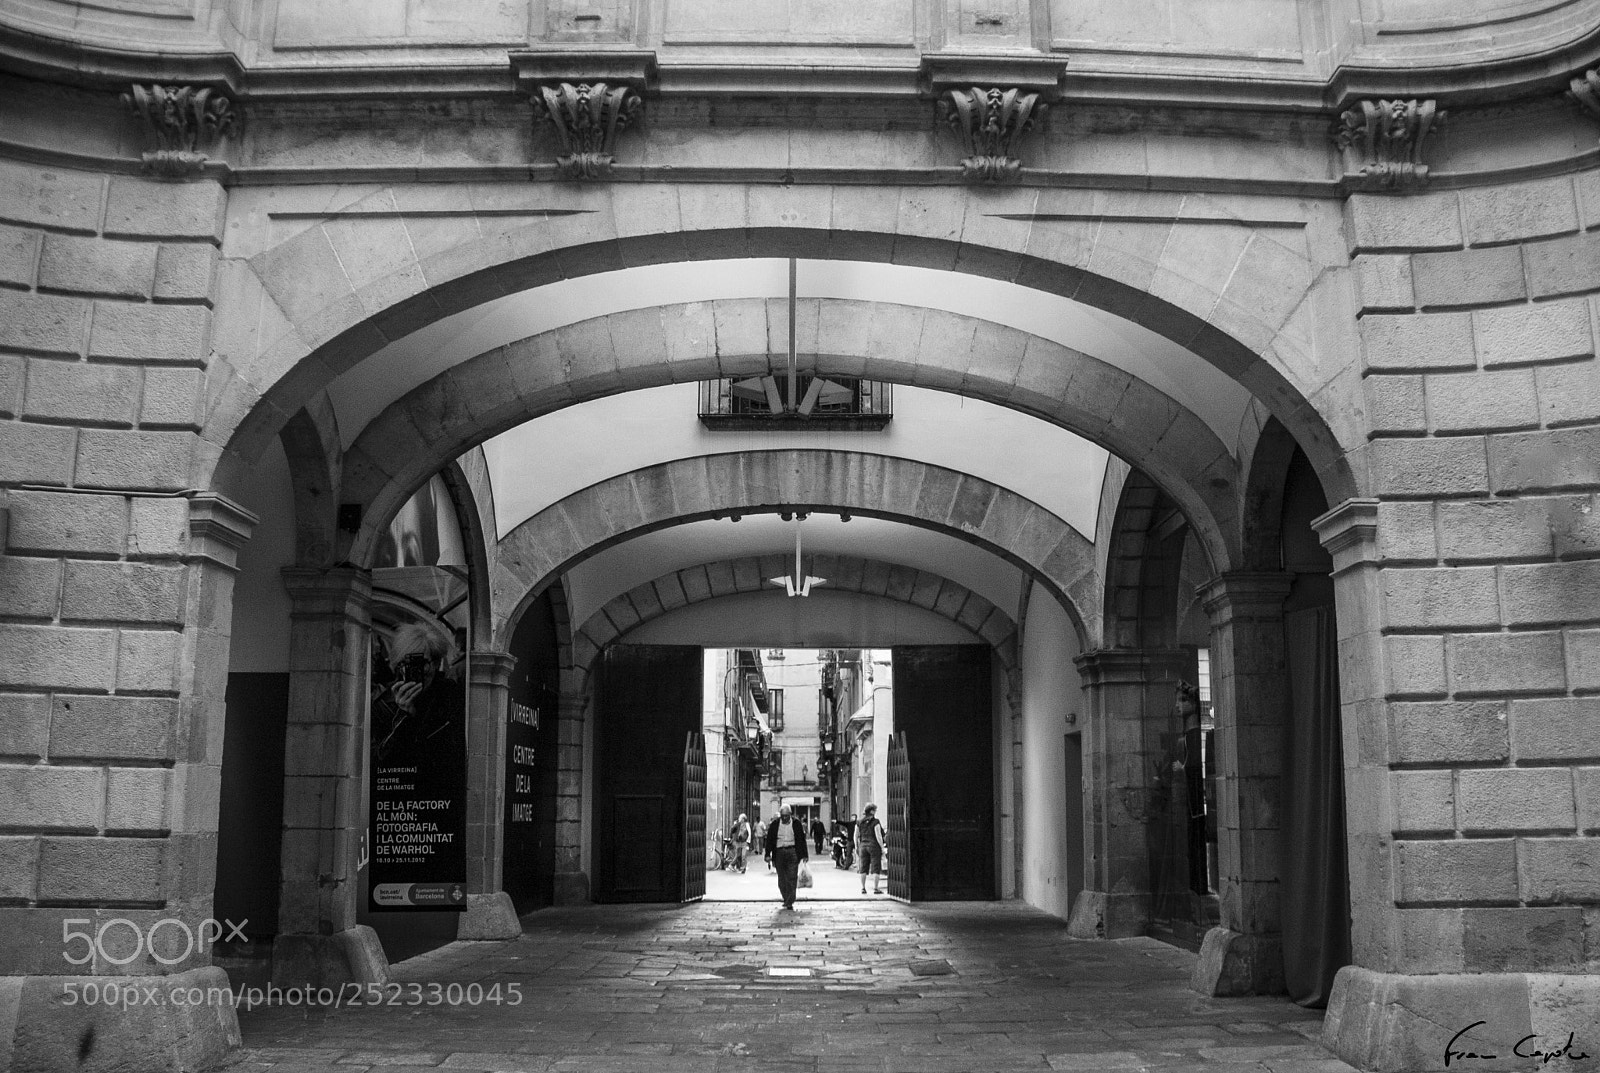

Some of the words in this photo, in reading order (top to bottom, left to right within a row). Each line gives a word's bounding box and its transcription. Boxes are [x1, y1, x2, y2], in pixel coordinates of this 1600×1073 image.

[513, 744, 535, 766] CENTRE
[376, 802, 390, 811] DE
[392, 801, 404, 810] LA
[406, 800, 451, 810] FACTORY
[376, 812, 390, 822] AL
[390, 809, 418, 821] MÓN:
[512, 803, 533, 822] IMATGE
[376, 823, 438, 833] FOTOGRAFIA
[381, 834, 394, 843] LA
[396, 833, 454, 843] COMUNITAT
[376, 845, 390, 855] DE
[392, 845, 435, 854] WARHOL
